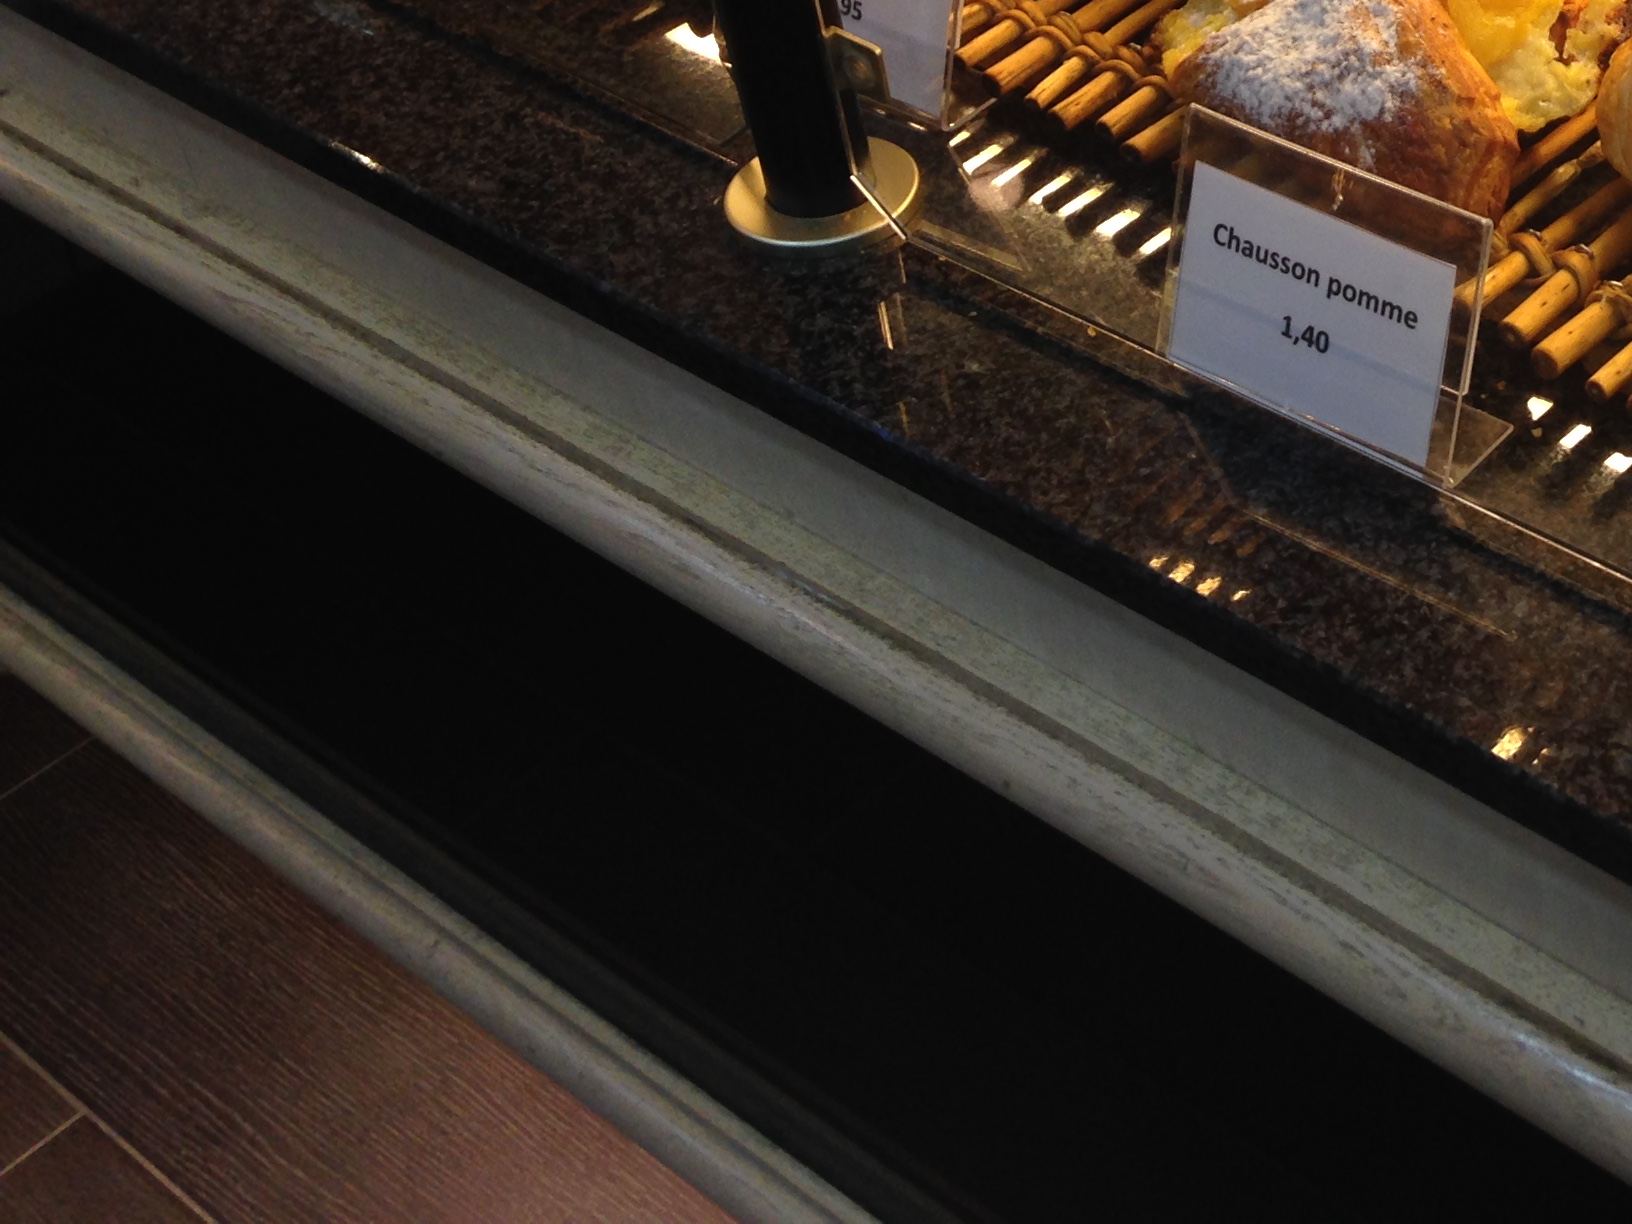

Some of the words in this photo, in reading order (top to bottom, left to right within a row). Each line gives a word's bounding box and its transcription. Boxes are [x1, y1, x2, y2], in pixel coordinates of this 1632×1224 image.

[1213, 223, 1321, 288] Chausson
[1326, 276, 1418, 330] pomme
[1280, 315, 1331, 354] 1,40
